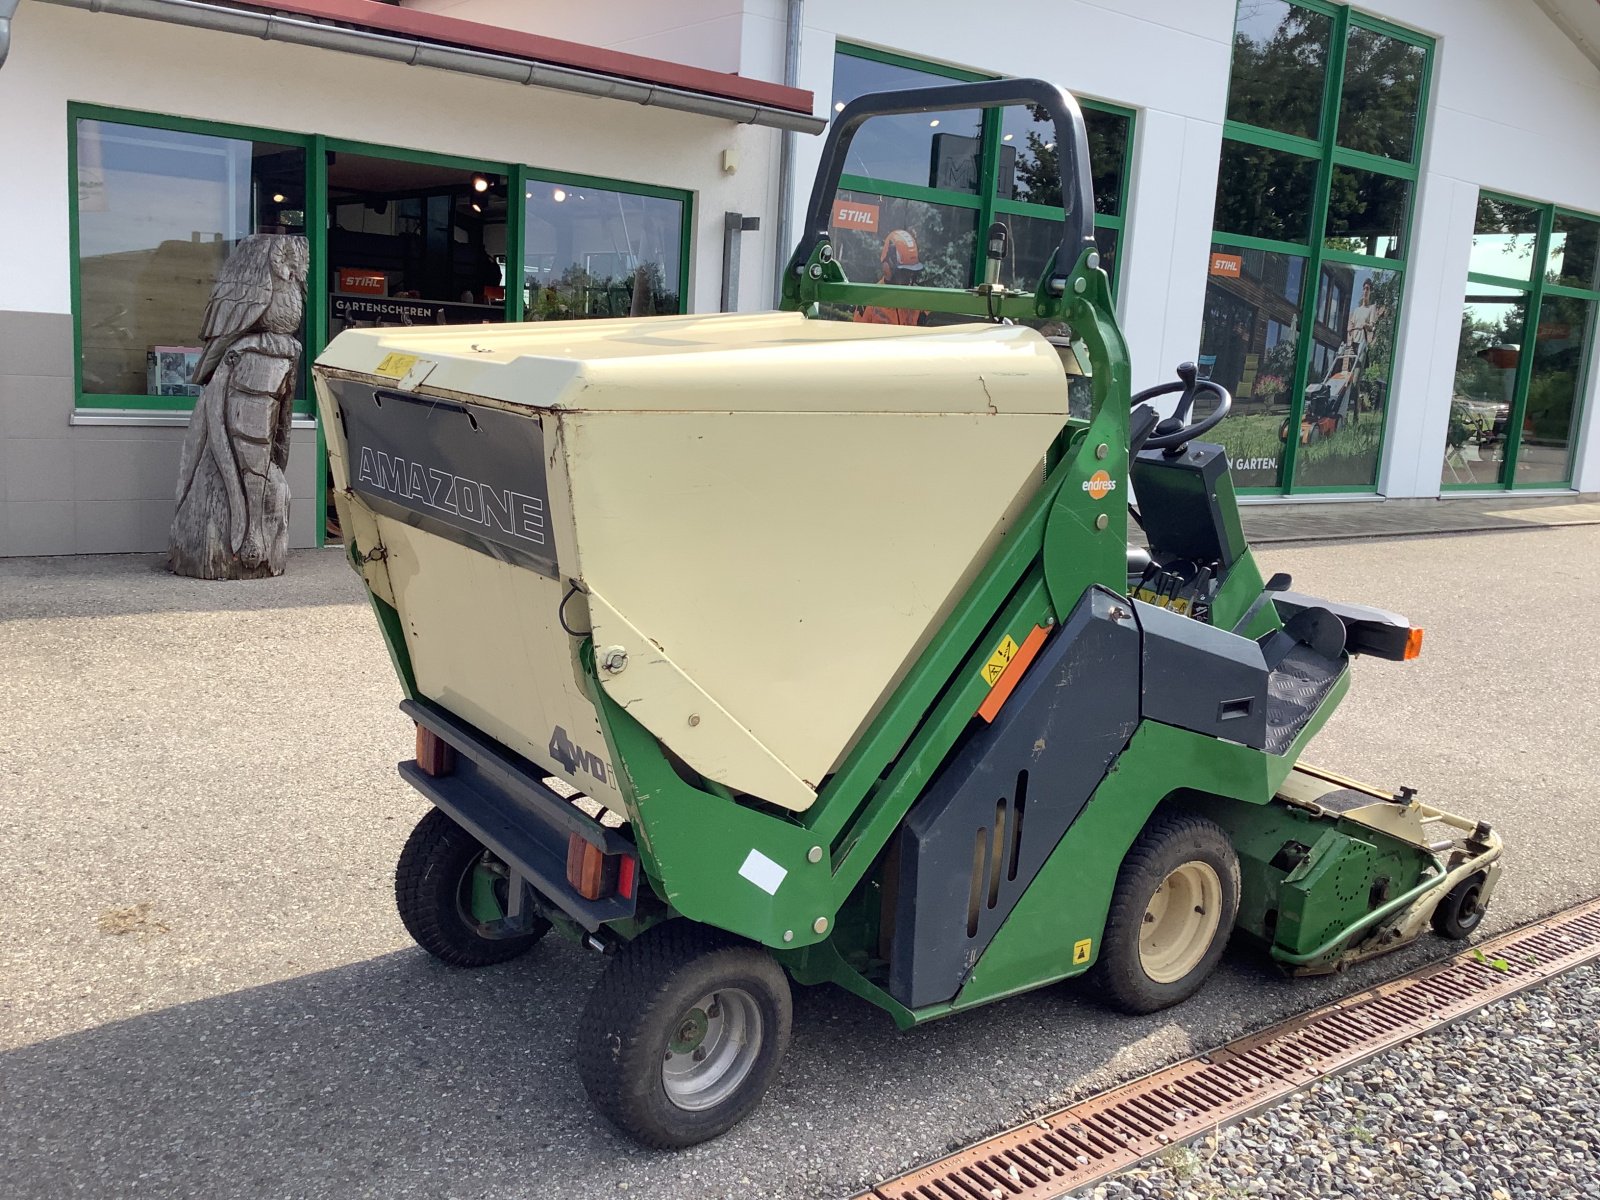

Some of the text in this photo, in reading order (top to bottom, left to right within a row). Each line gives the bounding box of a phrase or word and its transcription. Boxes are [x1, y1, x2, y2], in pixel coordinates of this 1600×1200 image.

[838, 208, 874, 225] STIHL
[1214, 259, 1238, 271] STIHL
[345, 276, 380, 287] STIHL
[336, 300, 431, 317] GARTENSCHEREN
[1236, 457, 1278, 470] GARTEN.
[1082, 477, 1116, 491] endress
[358, 446, 545, 545] AMAZONE
